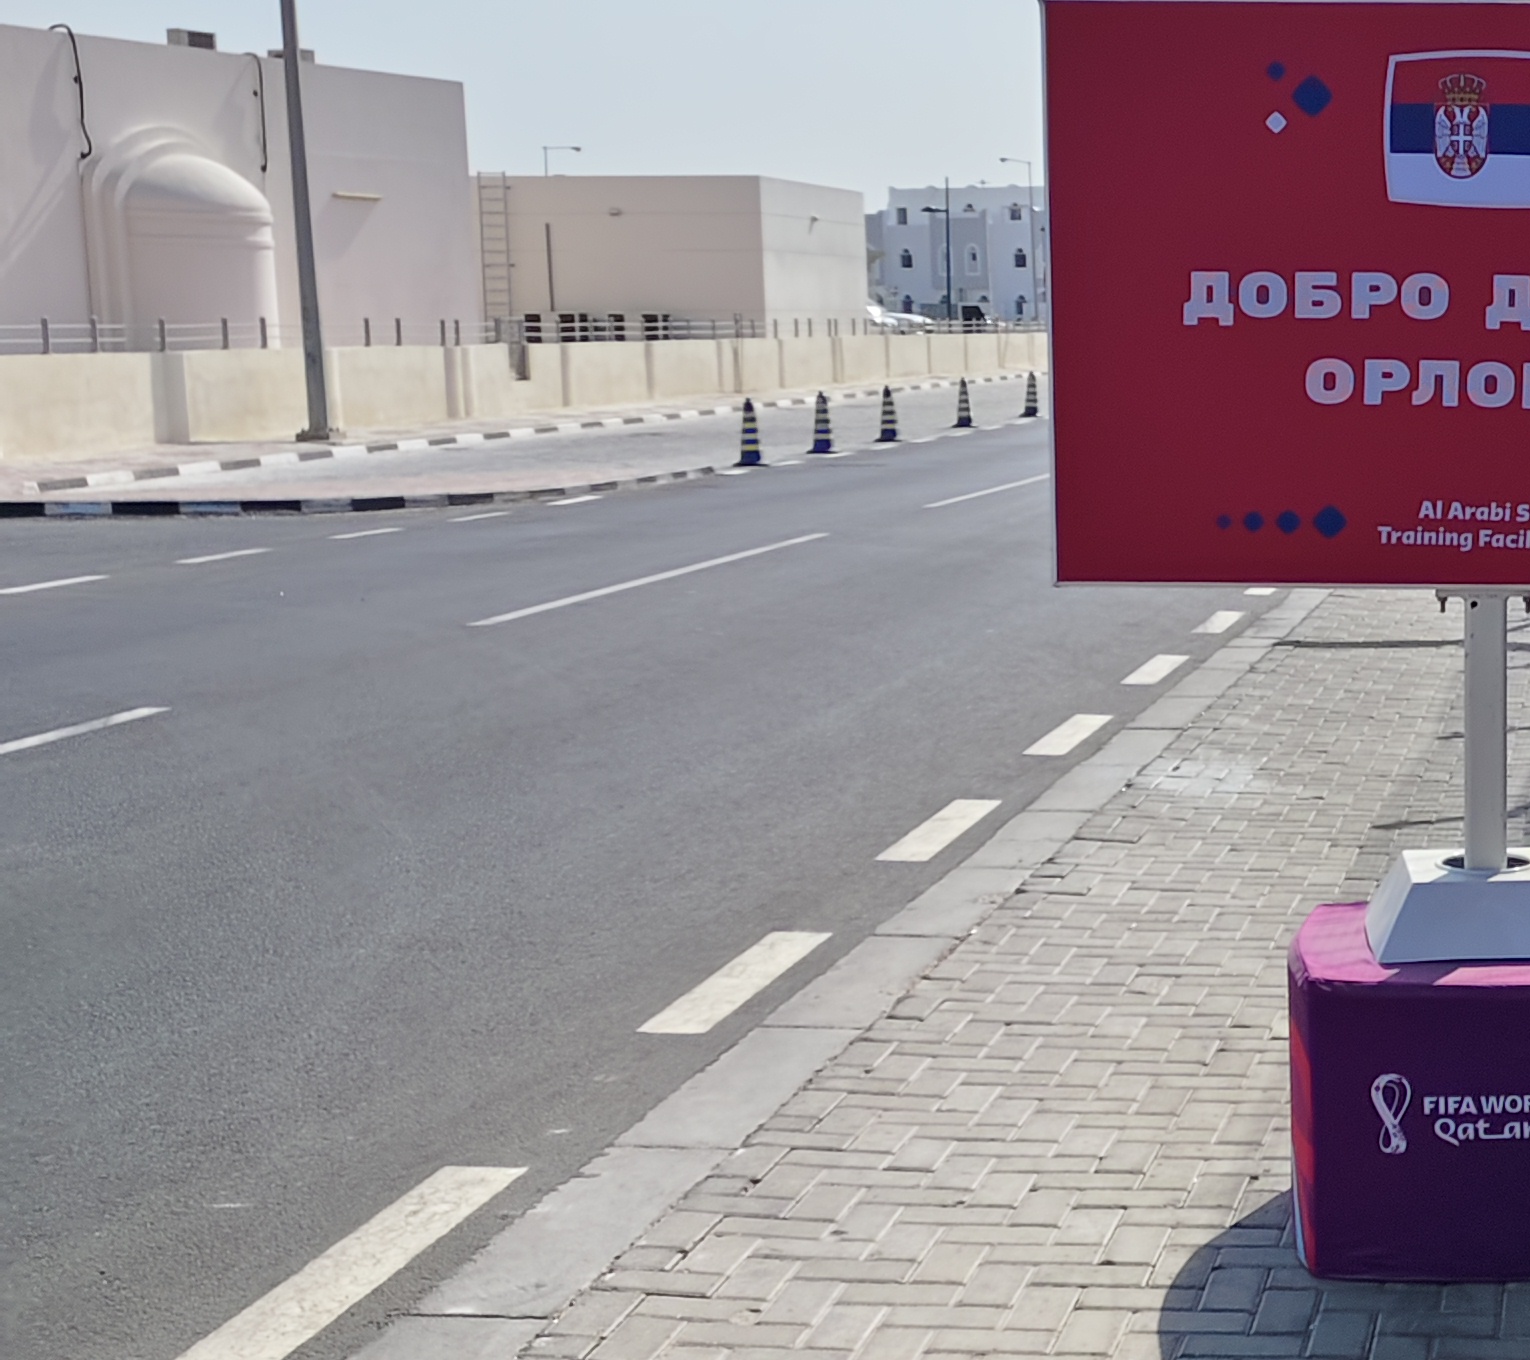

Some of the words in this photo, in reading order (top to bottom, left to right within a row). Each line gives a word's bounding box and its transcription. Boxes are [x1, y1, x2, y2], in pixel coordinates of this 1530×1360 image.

[1182, 270, 1450, 327] ДОБРО
[1418, 500, 1443, 520] Al
[1447, 501, 1512, 522] Arabi
[1377, 525, 1473, 552] Training
[1423, 1095, 1478, 1116] FIFA
